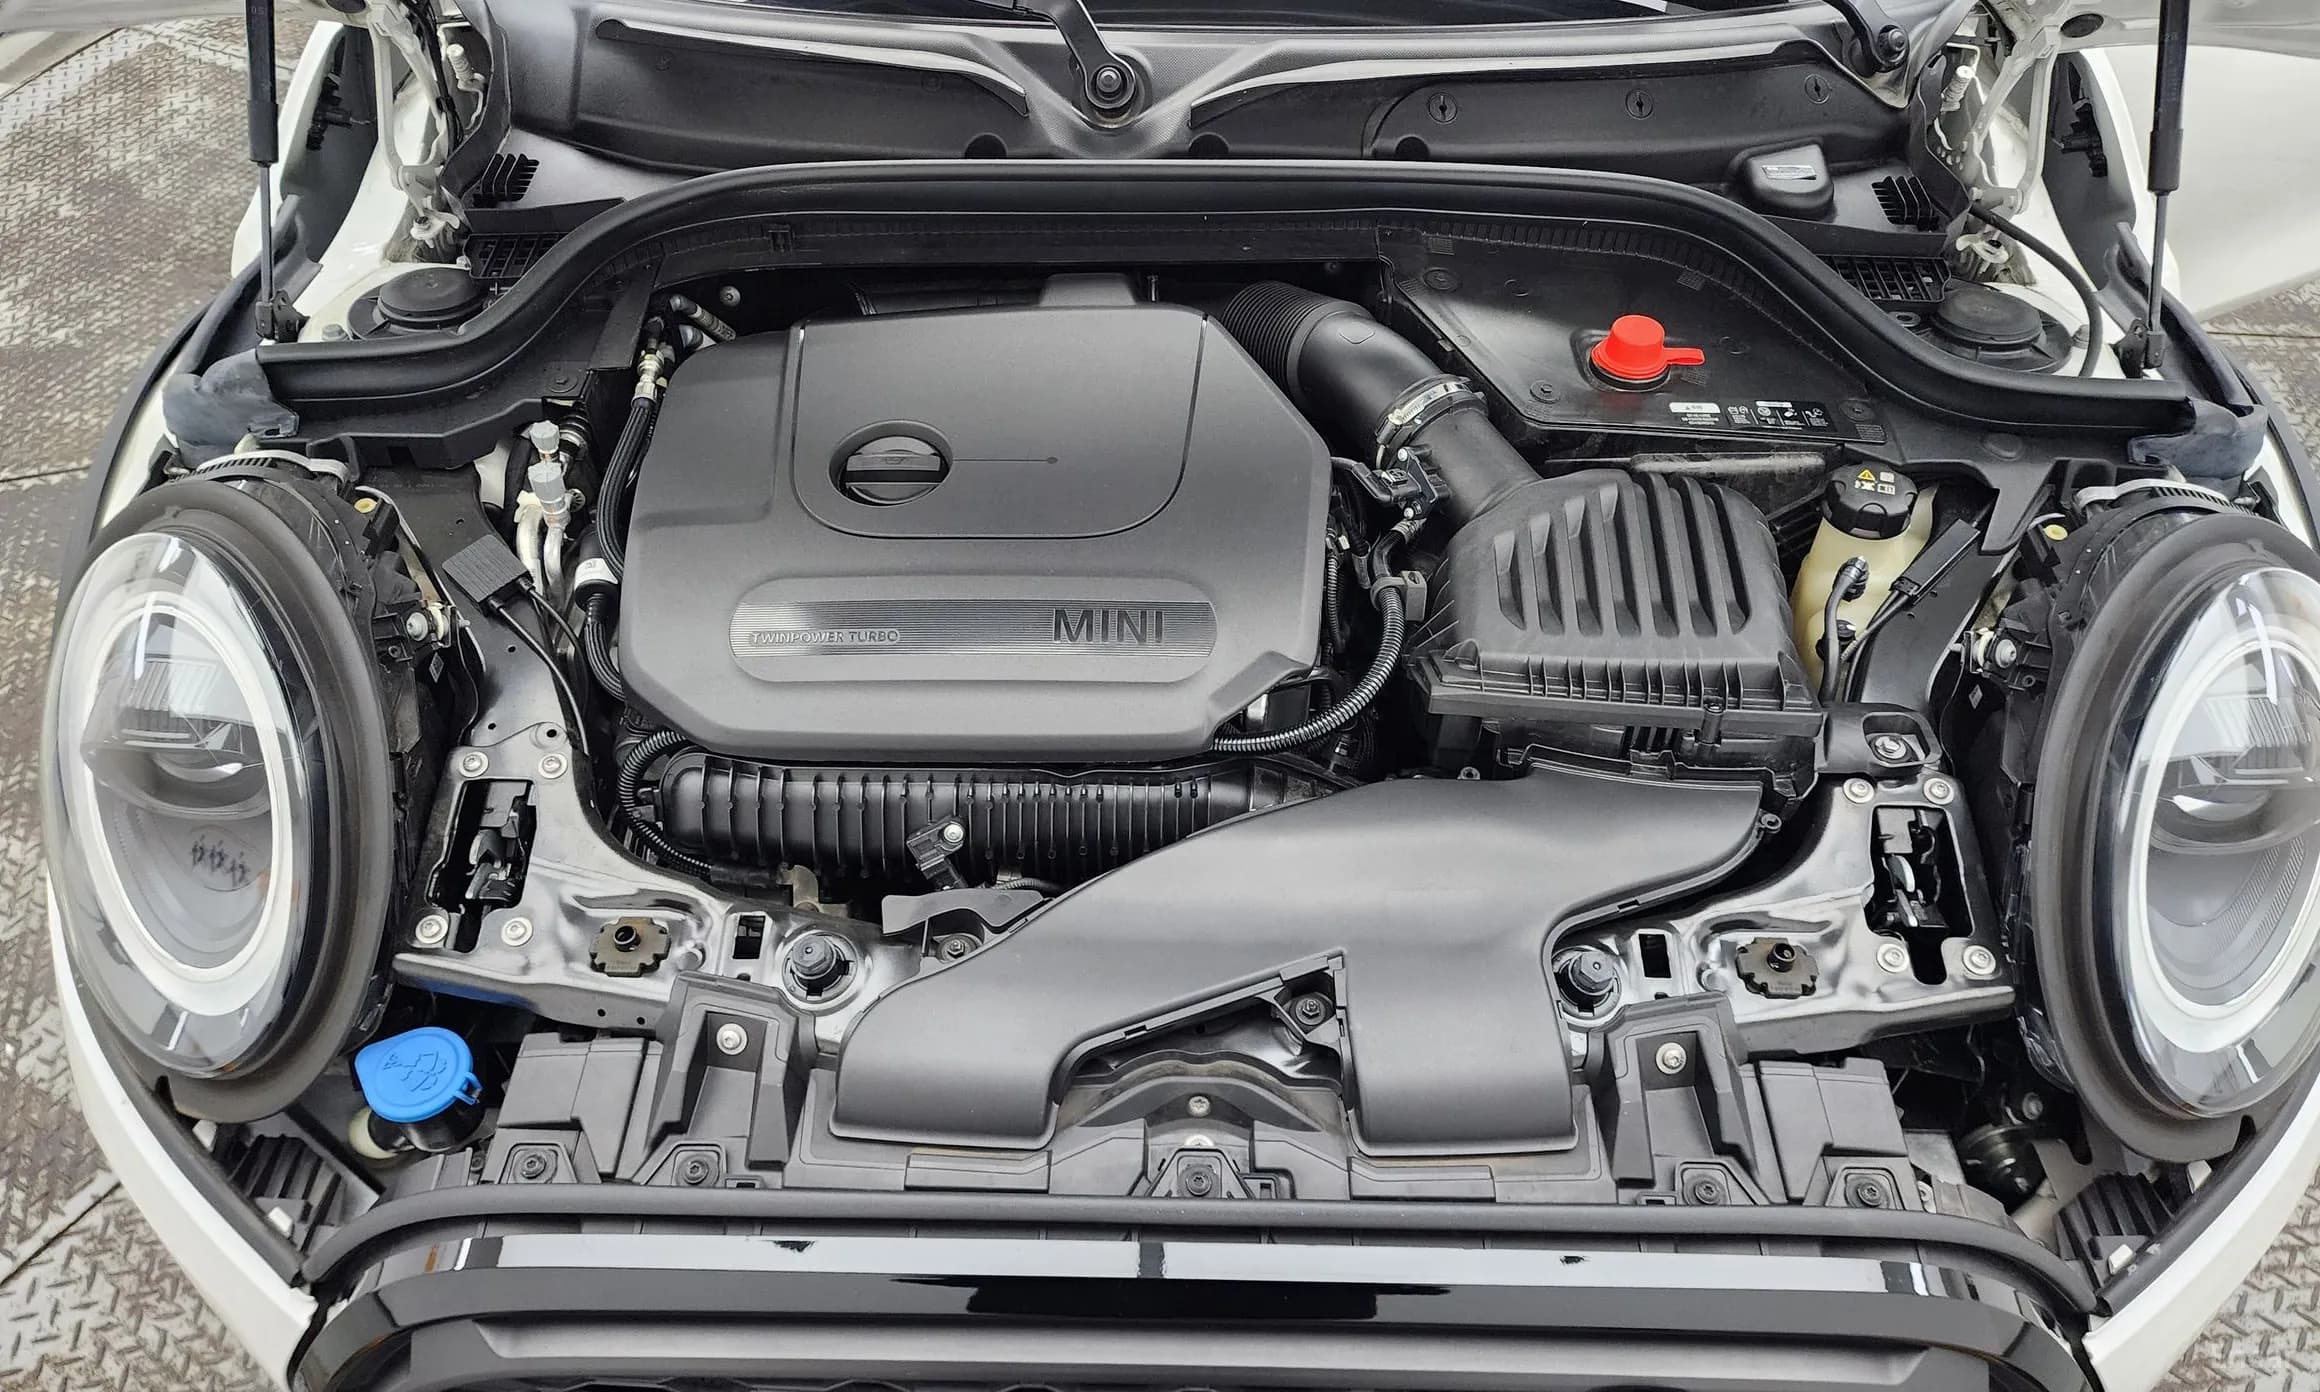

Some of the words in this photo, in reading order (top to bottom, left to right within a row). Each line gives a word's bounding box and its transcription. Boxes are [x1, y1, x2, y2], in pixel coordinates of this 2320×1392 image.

[751, 631, 844, 644] TWINPOWER
[849, 630, 899, 643] TURBO
[1053, 608, 1163, 644] MINI
